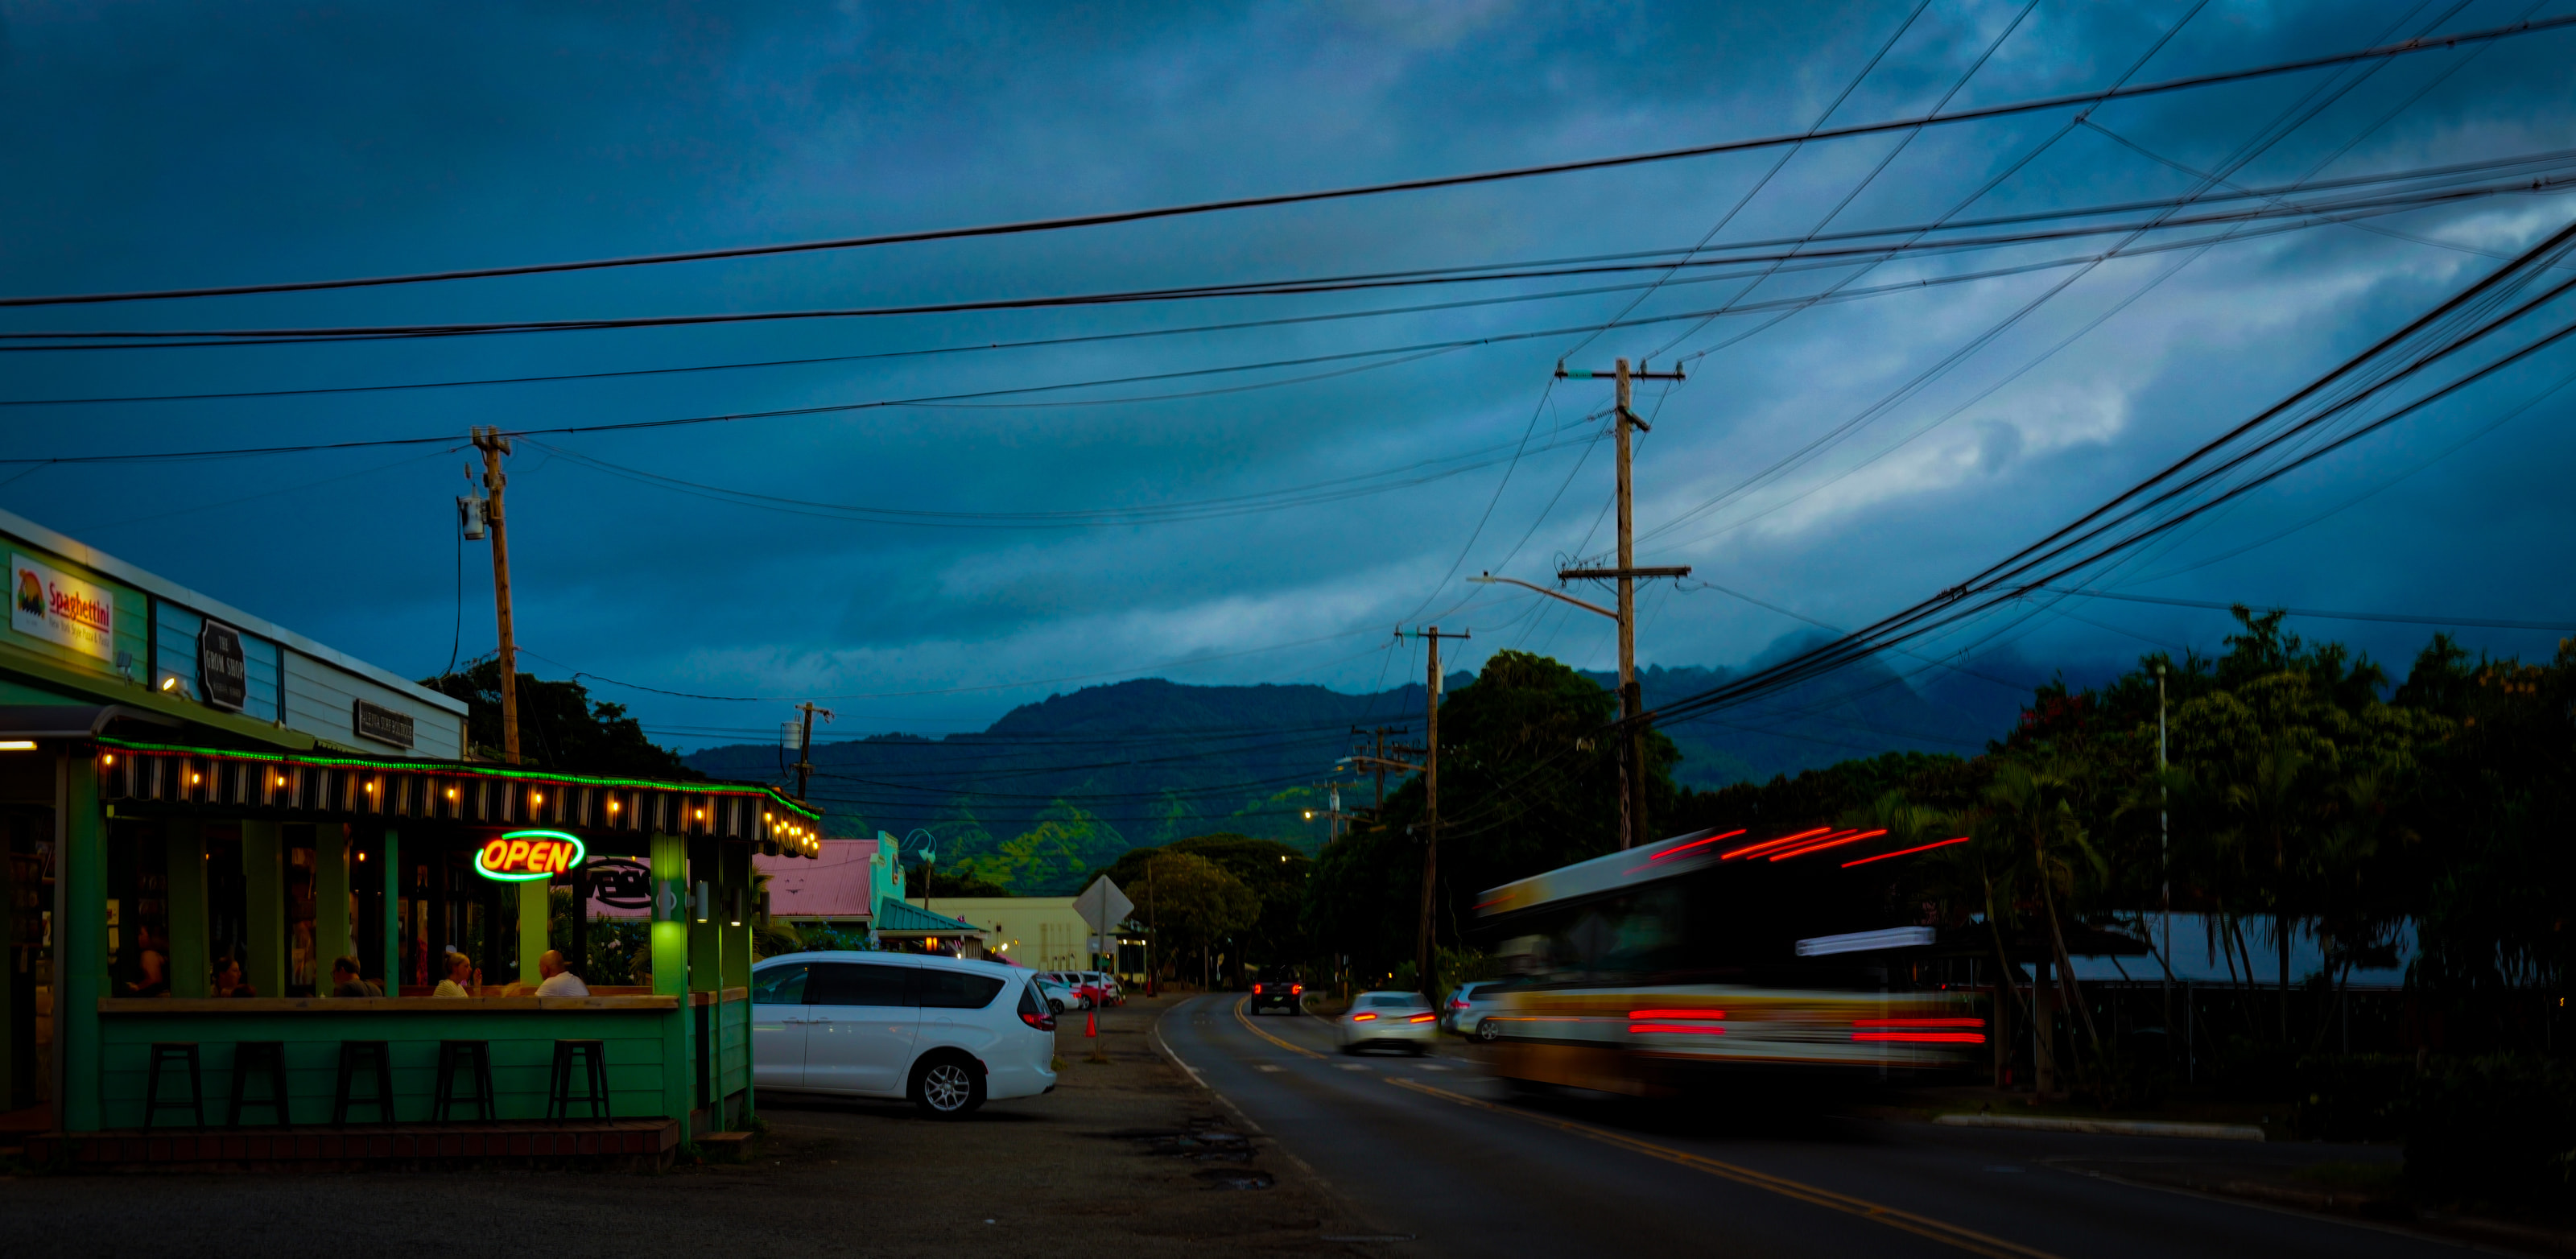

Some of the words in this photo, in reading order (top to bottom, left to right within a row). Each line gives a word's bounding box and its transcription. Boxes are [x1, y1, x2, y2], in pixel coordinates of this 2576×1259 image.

[49, 581, 109, 627] Spaghettini
[219, 635, 229, 652] THE
[206, 650, 225, 673] GROM
[226, 656, 244, 680] SHOP
[482, 839, 573, 873] OPEN
